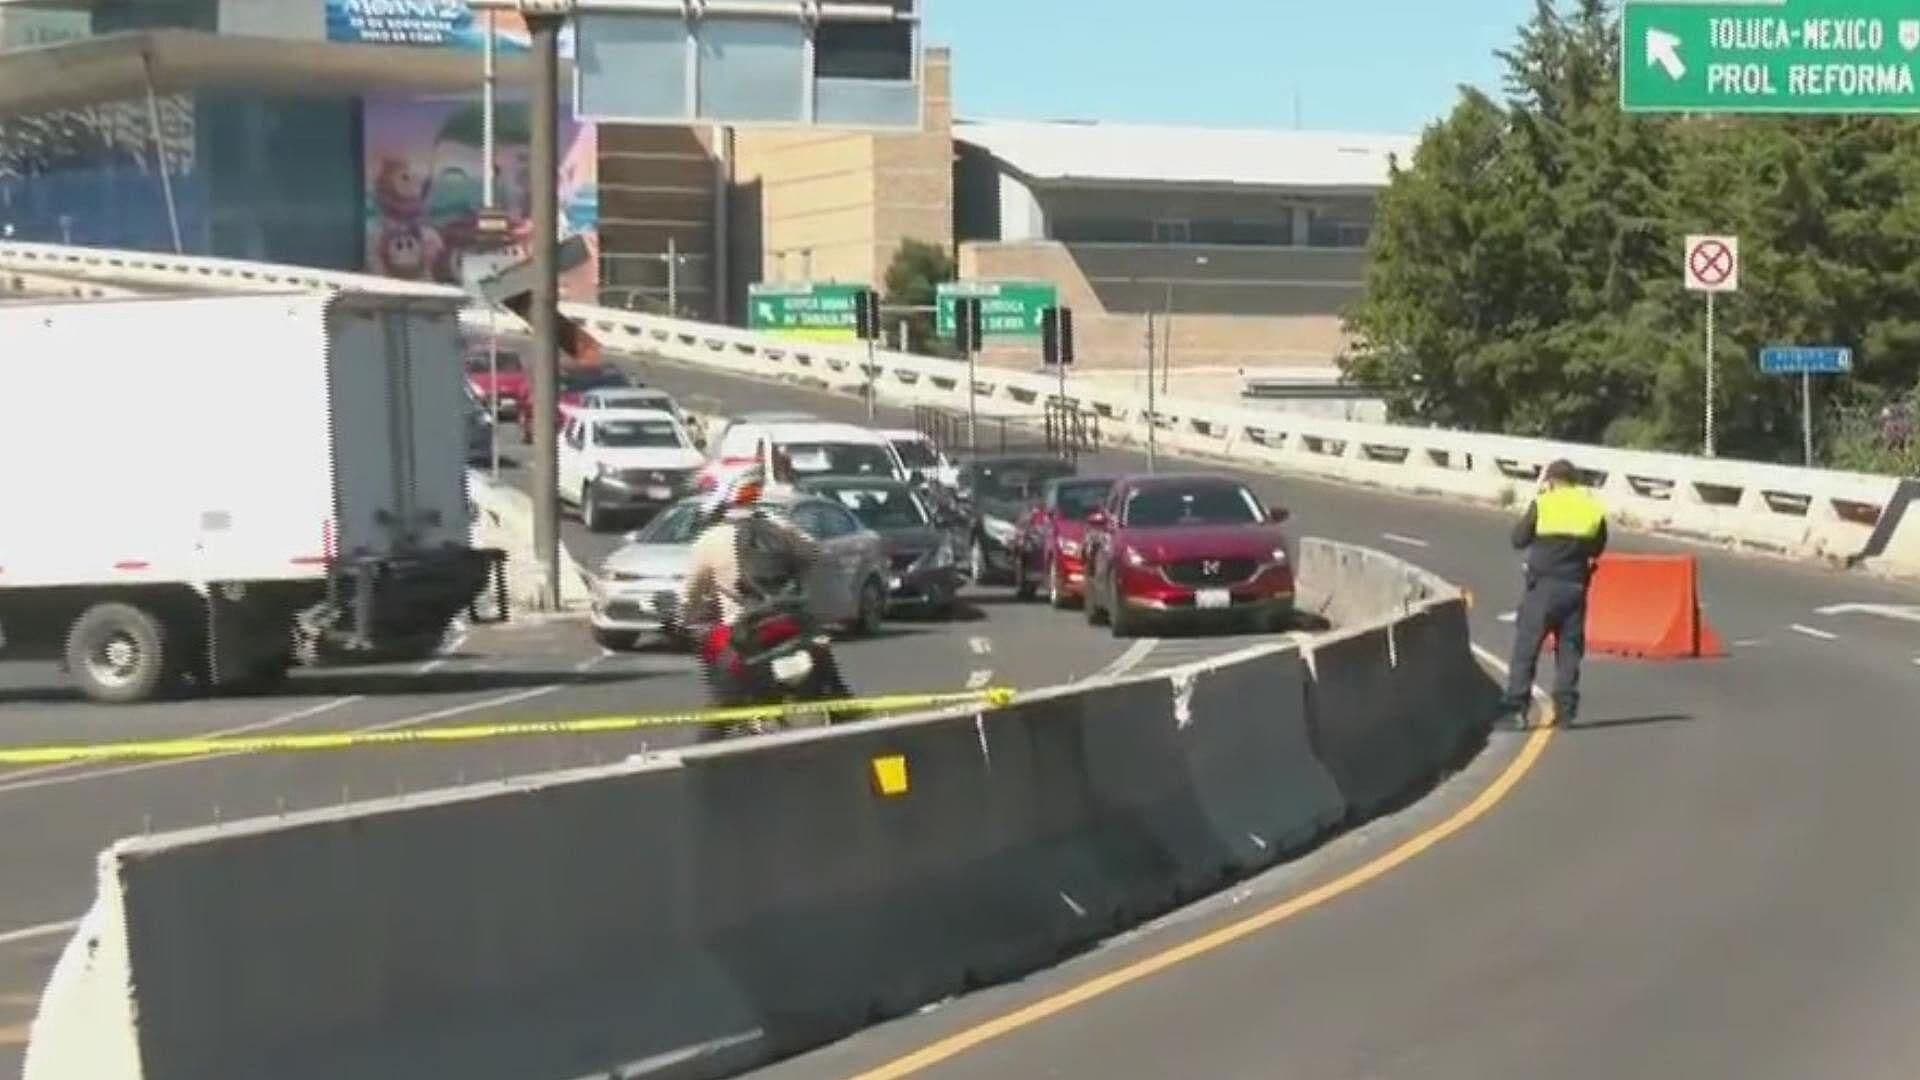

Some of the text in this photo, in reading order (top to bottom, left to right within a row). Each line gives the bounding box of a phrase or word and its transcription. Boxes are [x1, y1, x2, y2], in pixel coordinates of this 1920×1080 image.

[1709, 18, 1883, 50] TOLUCA-MEXICO
[1707, 63, 1915, 94] PROL REFORMA
